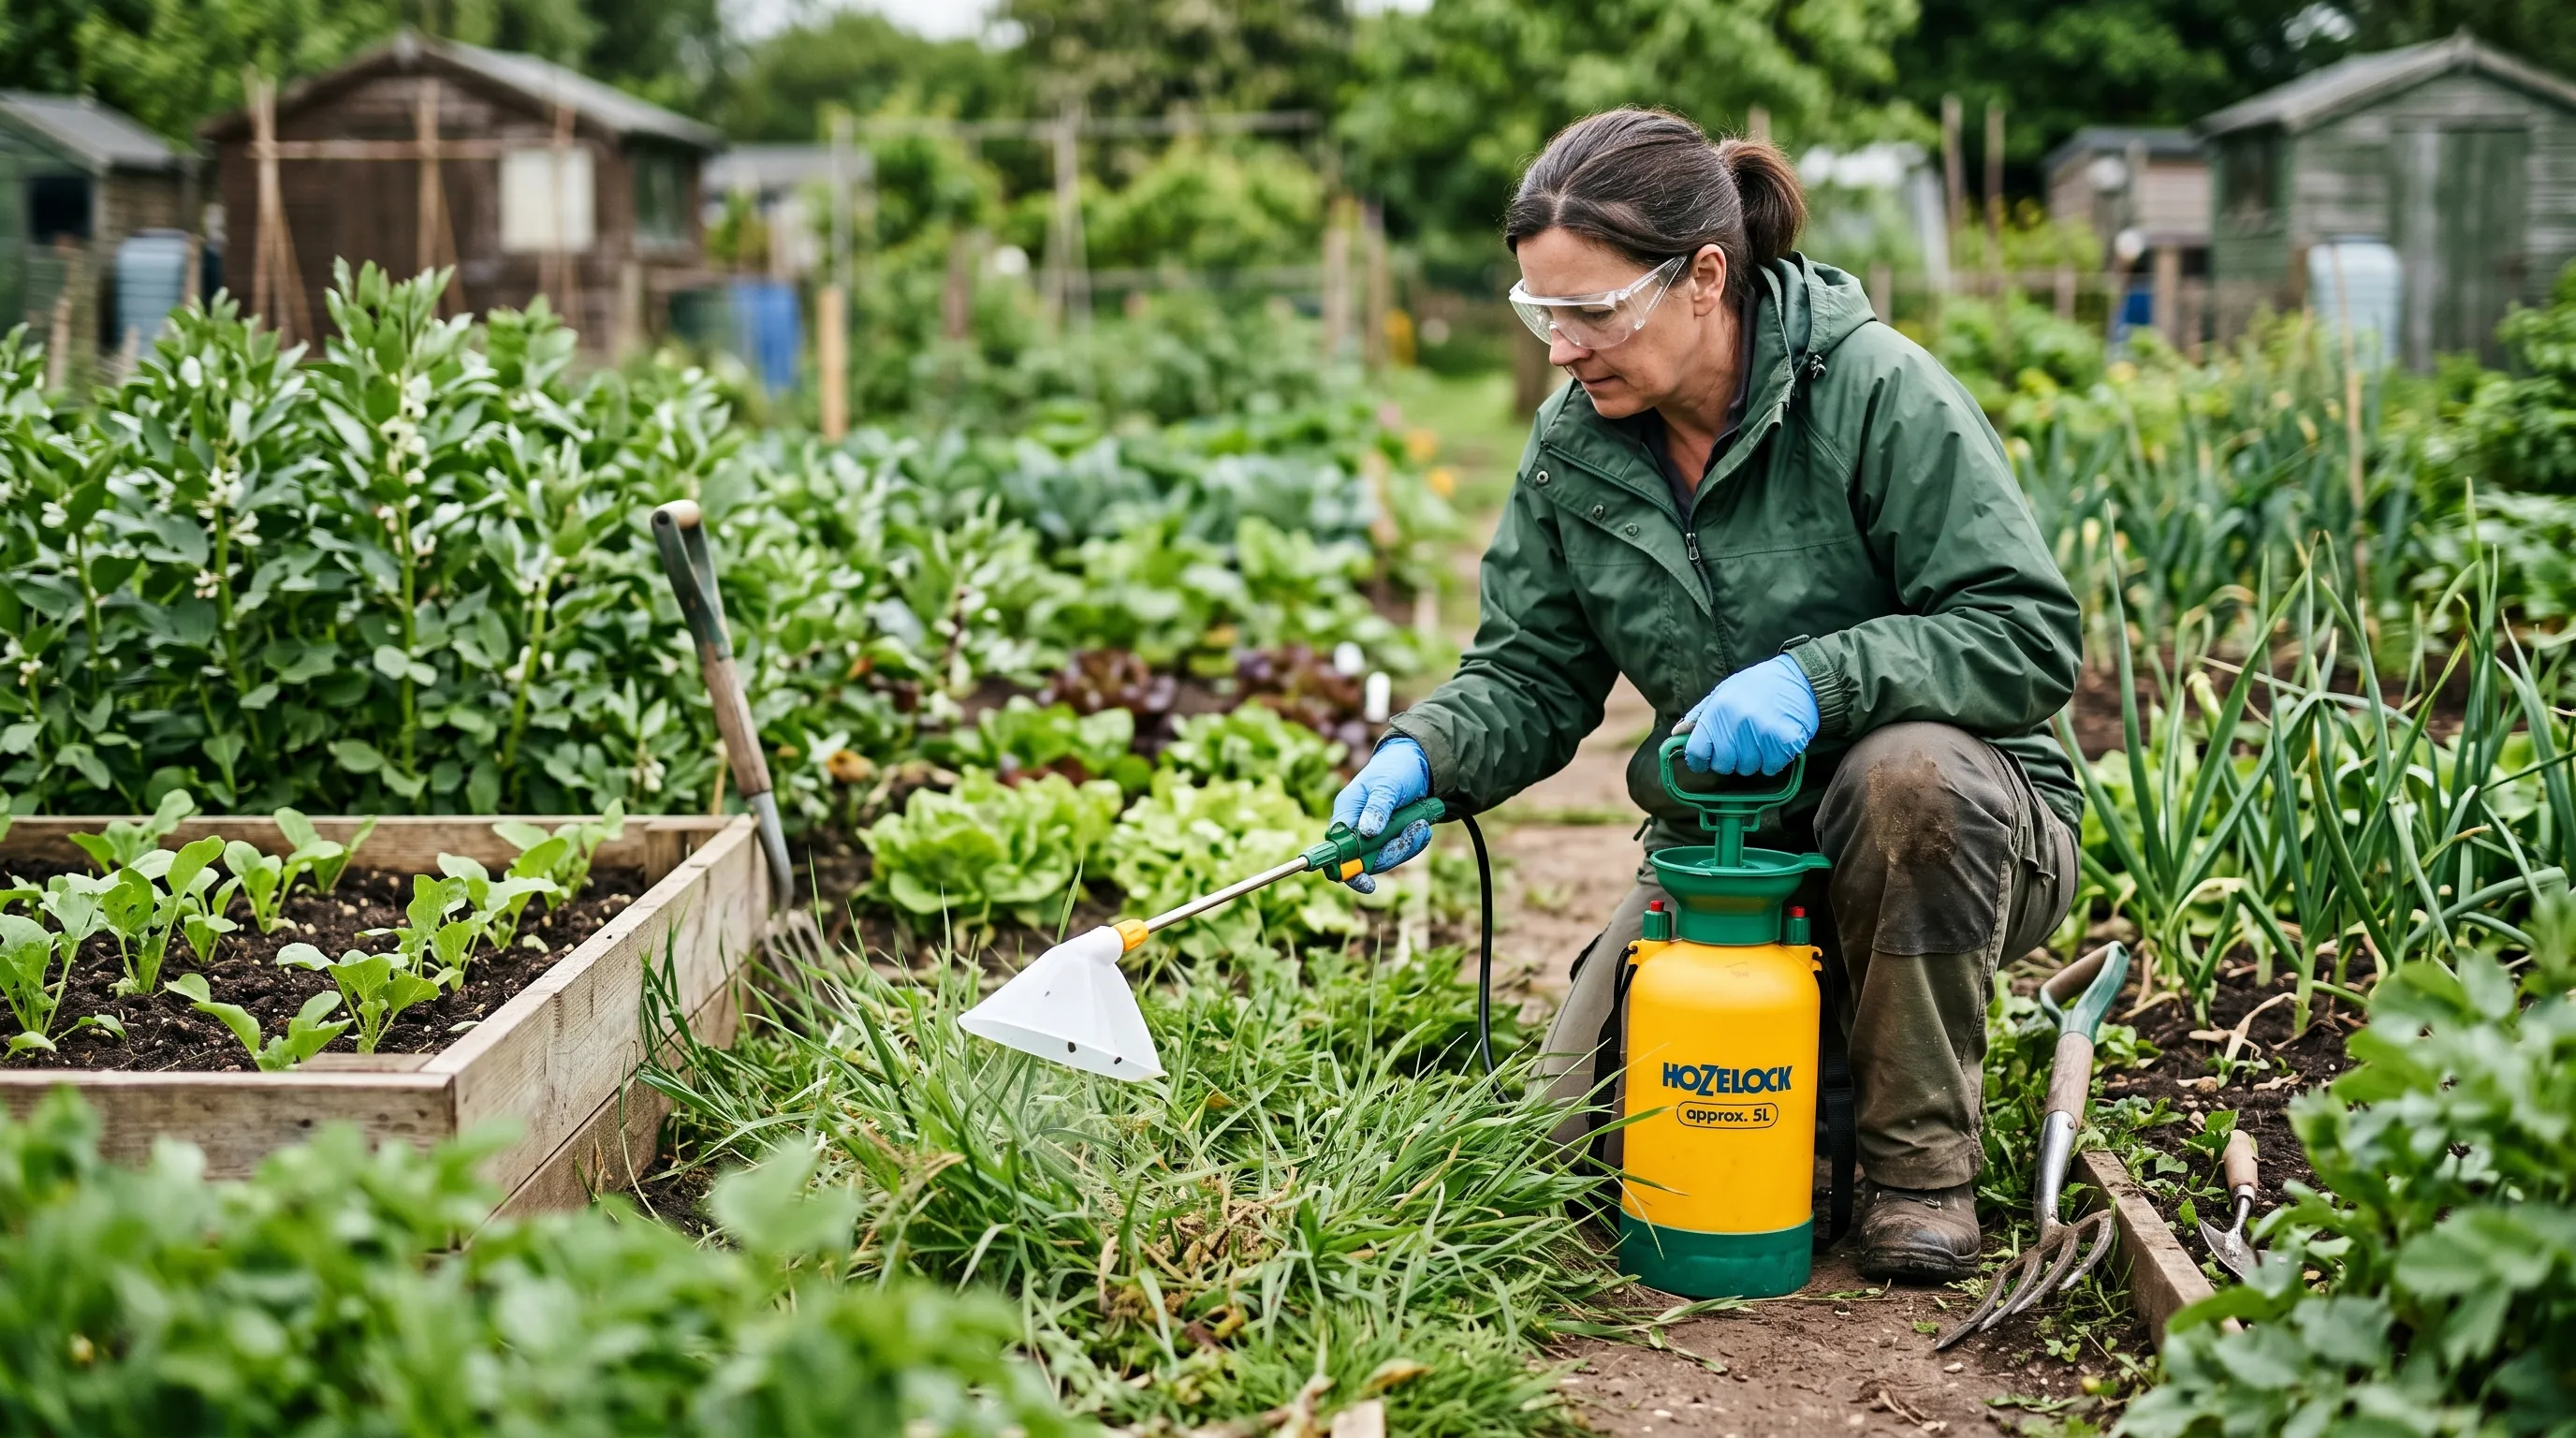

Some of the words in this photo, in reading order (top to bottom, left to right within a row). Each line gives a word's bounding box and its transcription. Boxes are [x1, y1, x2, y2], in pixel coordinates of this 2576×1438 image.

[1662, 1062, 1793, 1097] HOZELOCK
[1686, 1108, 1749, 1124] approx.
[1752, 1108, 1770, 1123] 5L
